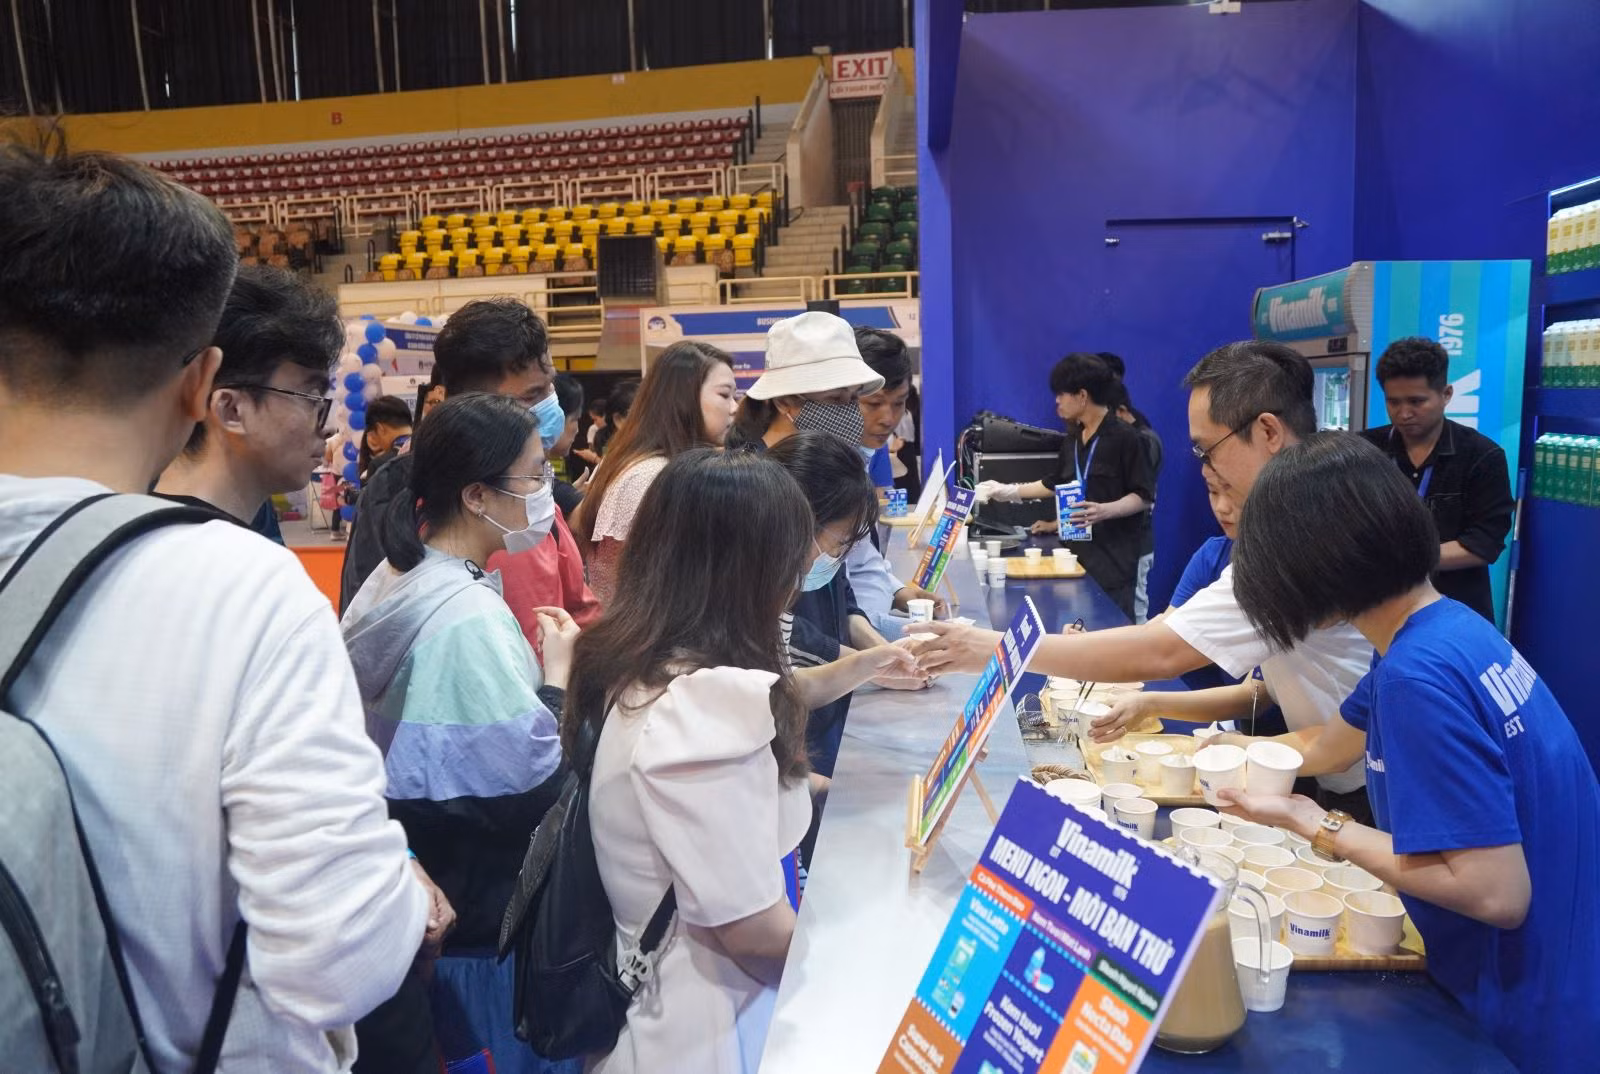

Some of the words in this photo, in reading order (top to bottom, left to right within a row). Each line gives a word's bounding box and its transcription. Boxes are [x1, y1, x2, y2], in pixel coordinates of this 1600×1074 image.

[837, 57, 888, 79] EXIT
[331, 111, 343, 126] B
[1439, 313, 1463, 356] 1976
[1503, 715, 1525, 739] EST
[1056, 818, 1139, 889] Vinamilk
[989, 834, 1033, 879] MENU
[1024, 857, 1069, 904] NGON
[1098, 906, 1140, 953] BẠN
[1290, 922, 1331, 938] Vinamilk
